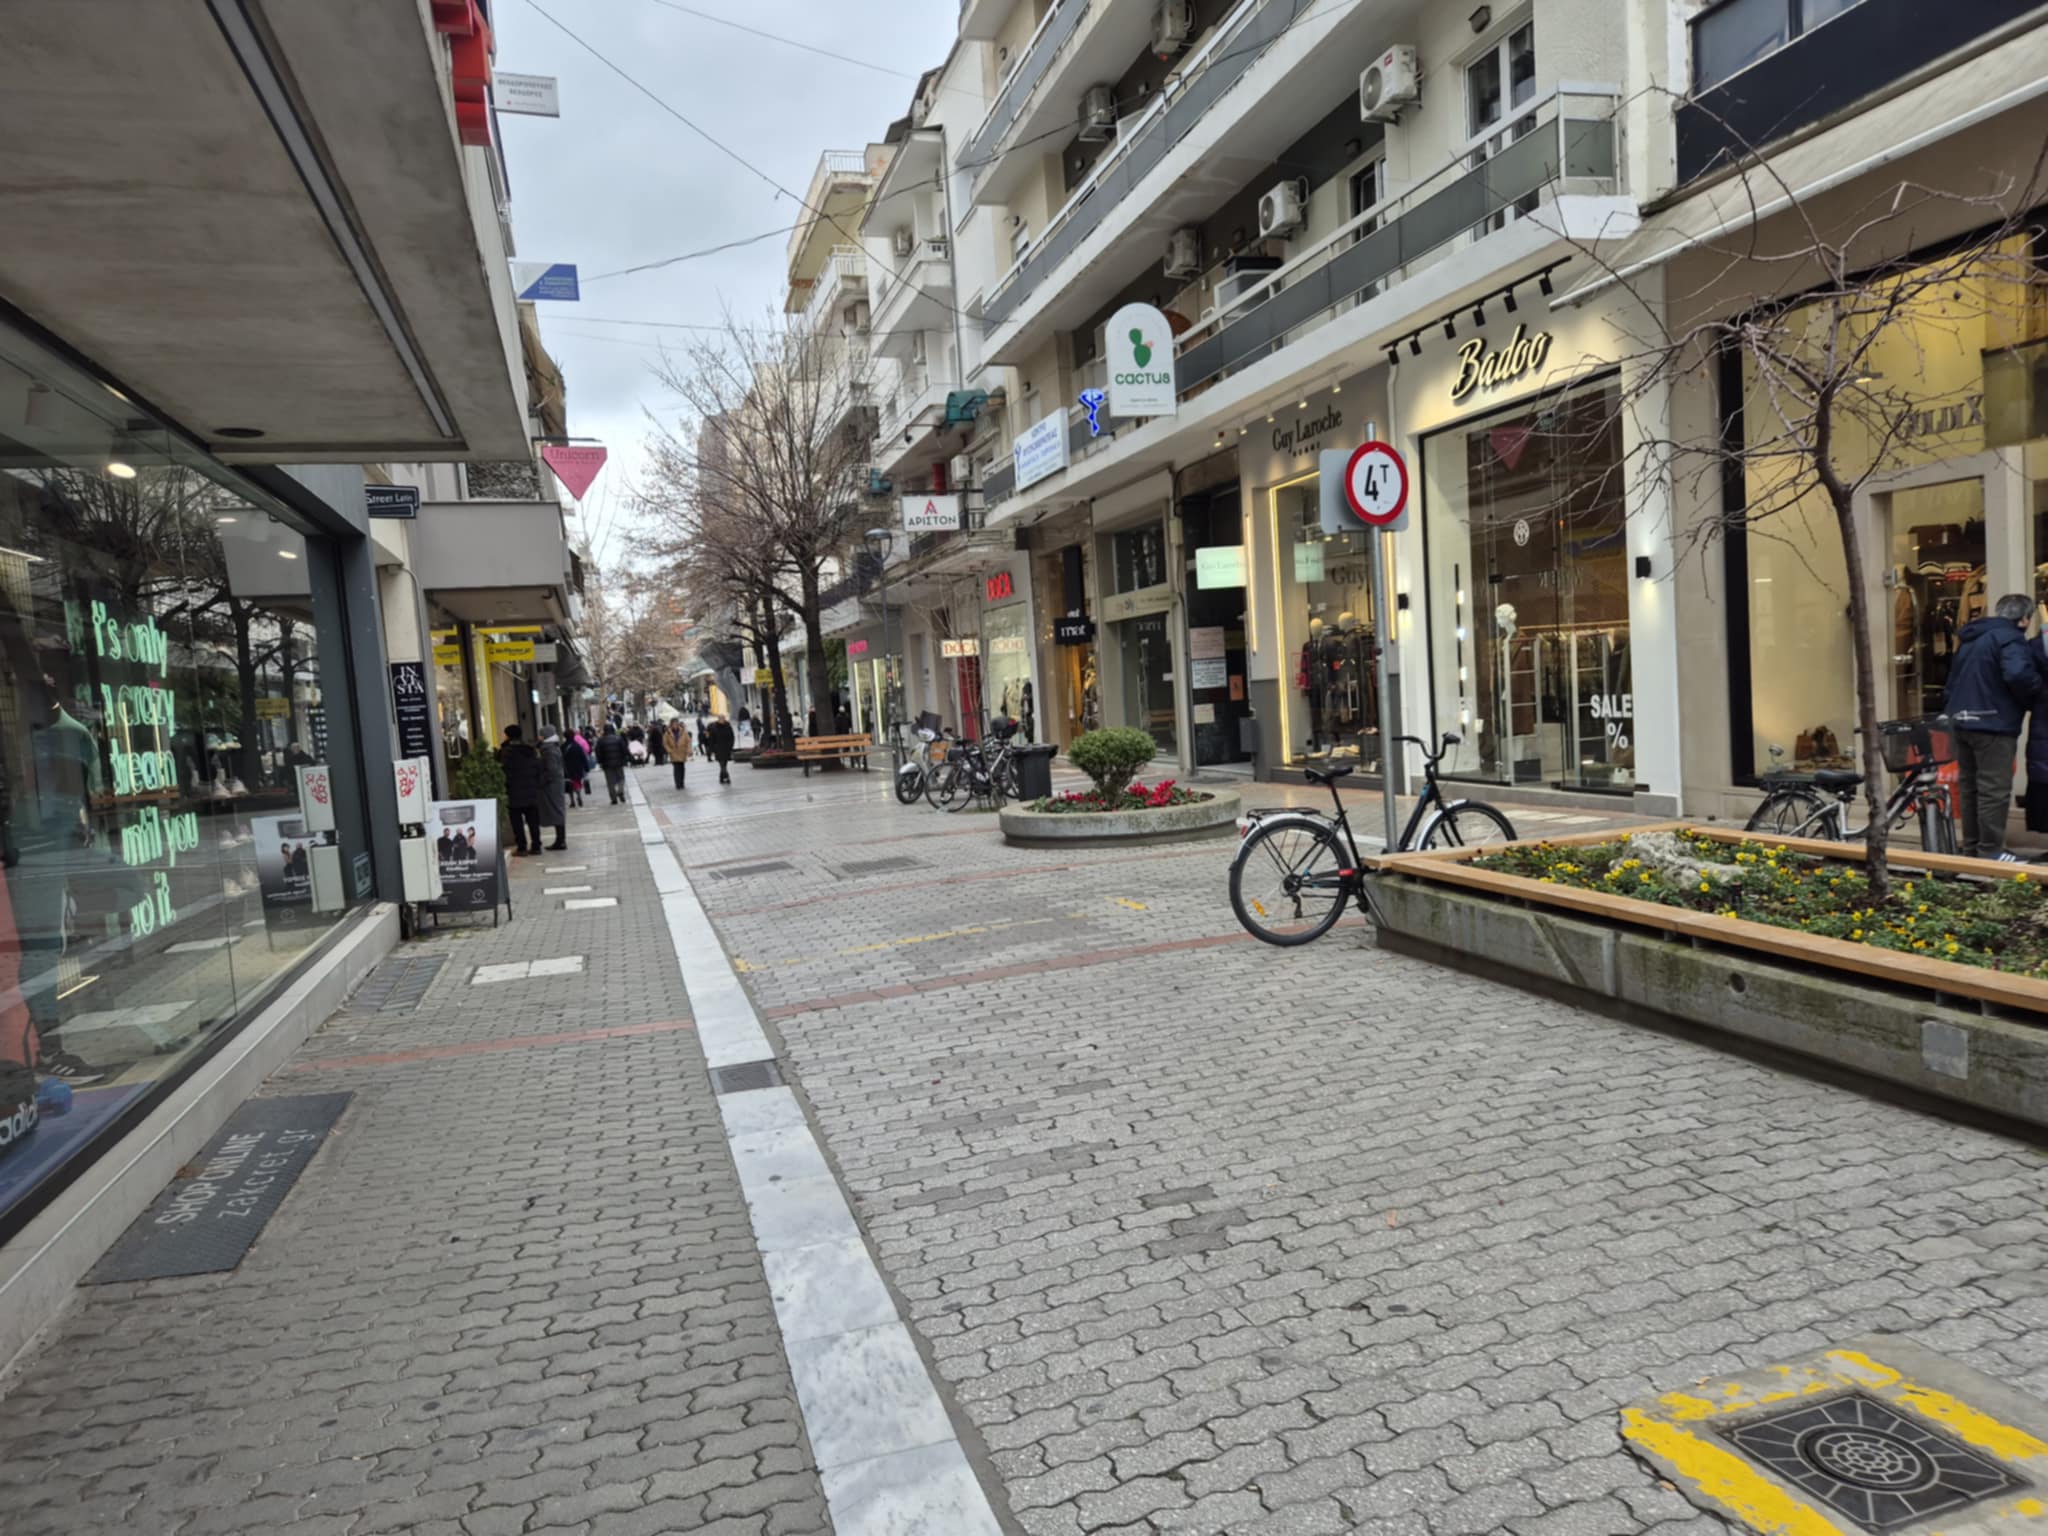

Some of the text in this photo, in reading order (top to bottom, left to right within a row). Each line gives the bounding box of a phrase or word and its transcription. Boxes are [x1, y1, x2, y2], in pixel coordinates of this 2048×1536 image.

[1449, 324, 1551, 400] Badoo
[1272, 428, 1295, 454] Guy
[1296, 405, 1343, 443] Laroche
[908, 515, 957, 526] ΑΡΙΣΤΟΝ
[124, 616, 168, 678] only
[1590, 694, 1633, 718] SALE
[1607, 722, 1628, 749] %
[163, 811, 199, 867] you
[154, 1131, 267, 1225] SHOP ONLINE
